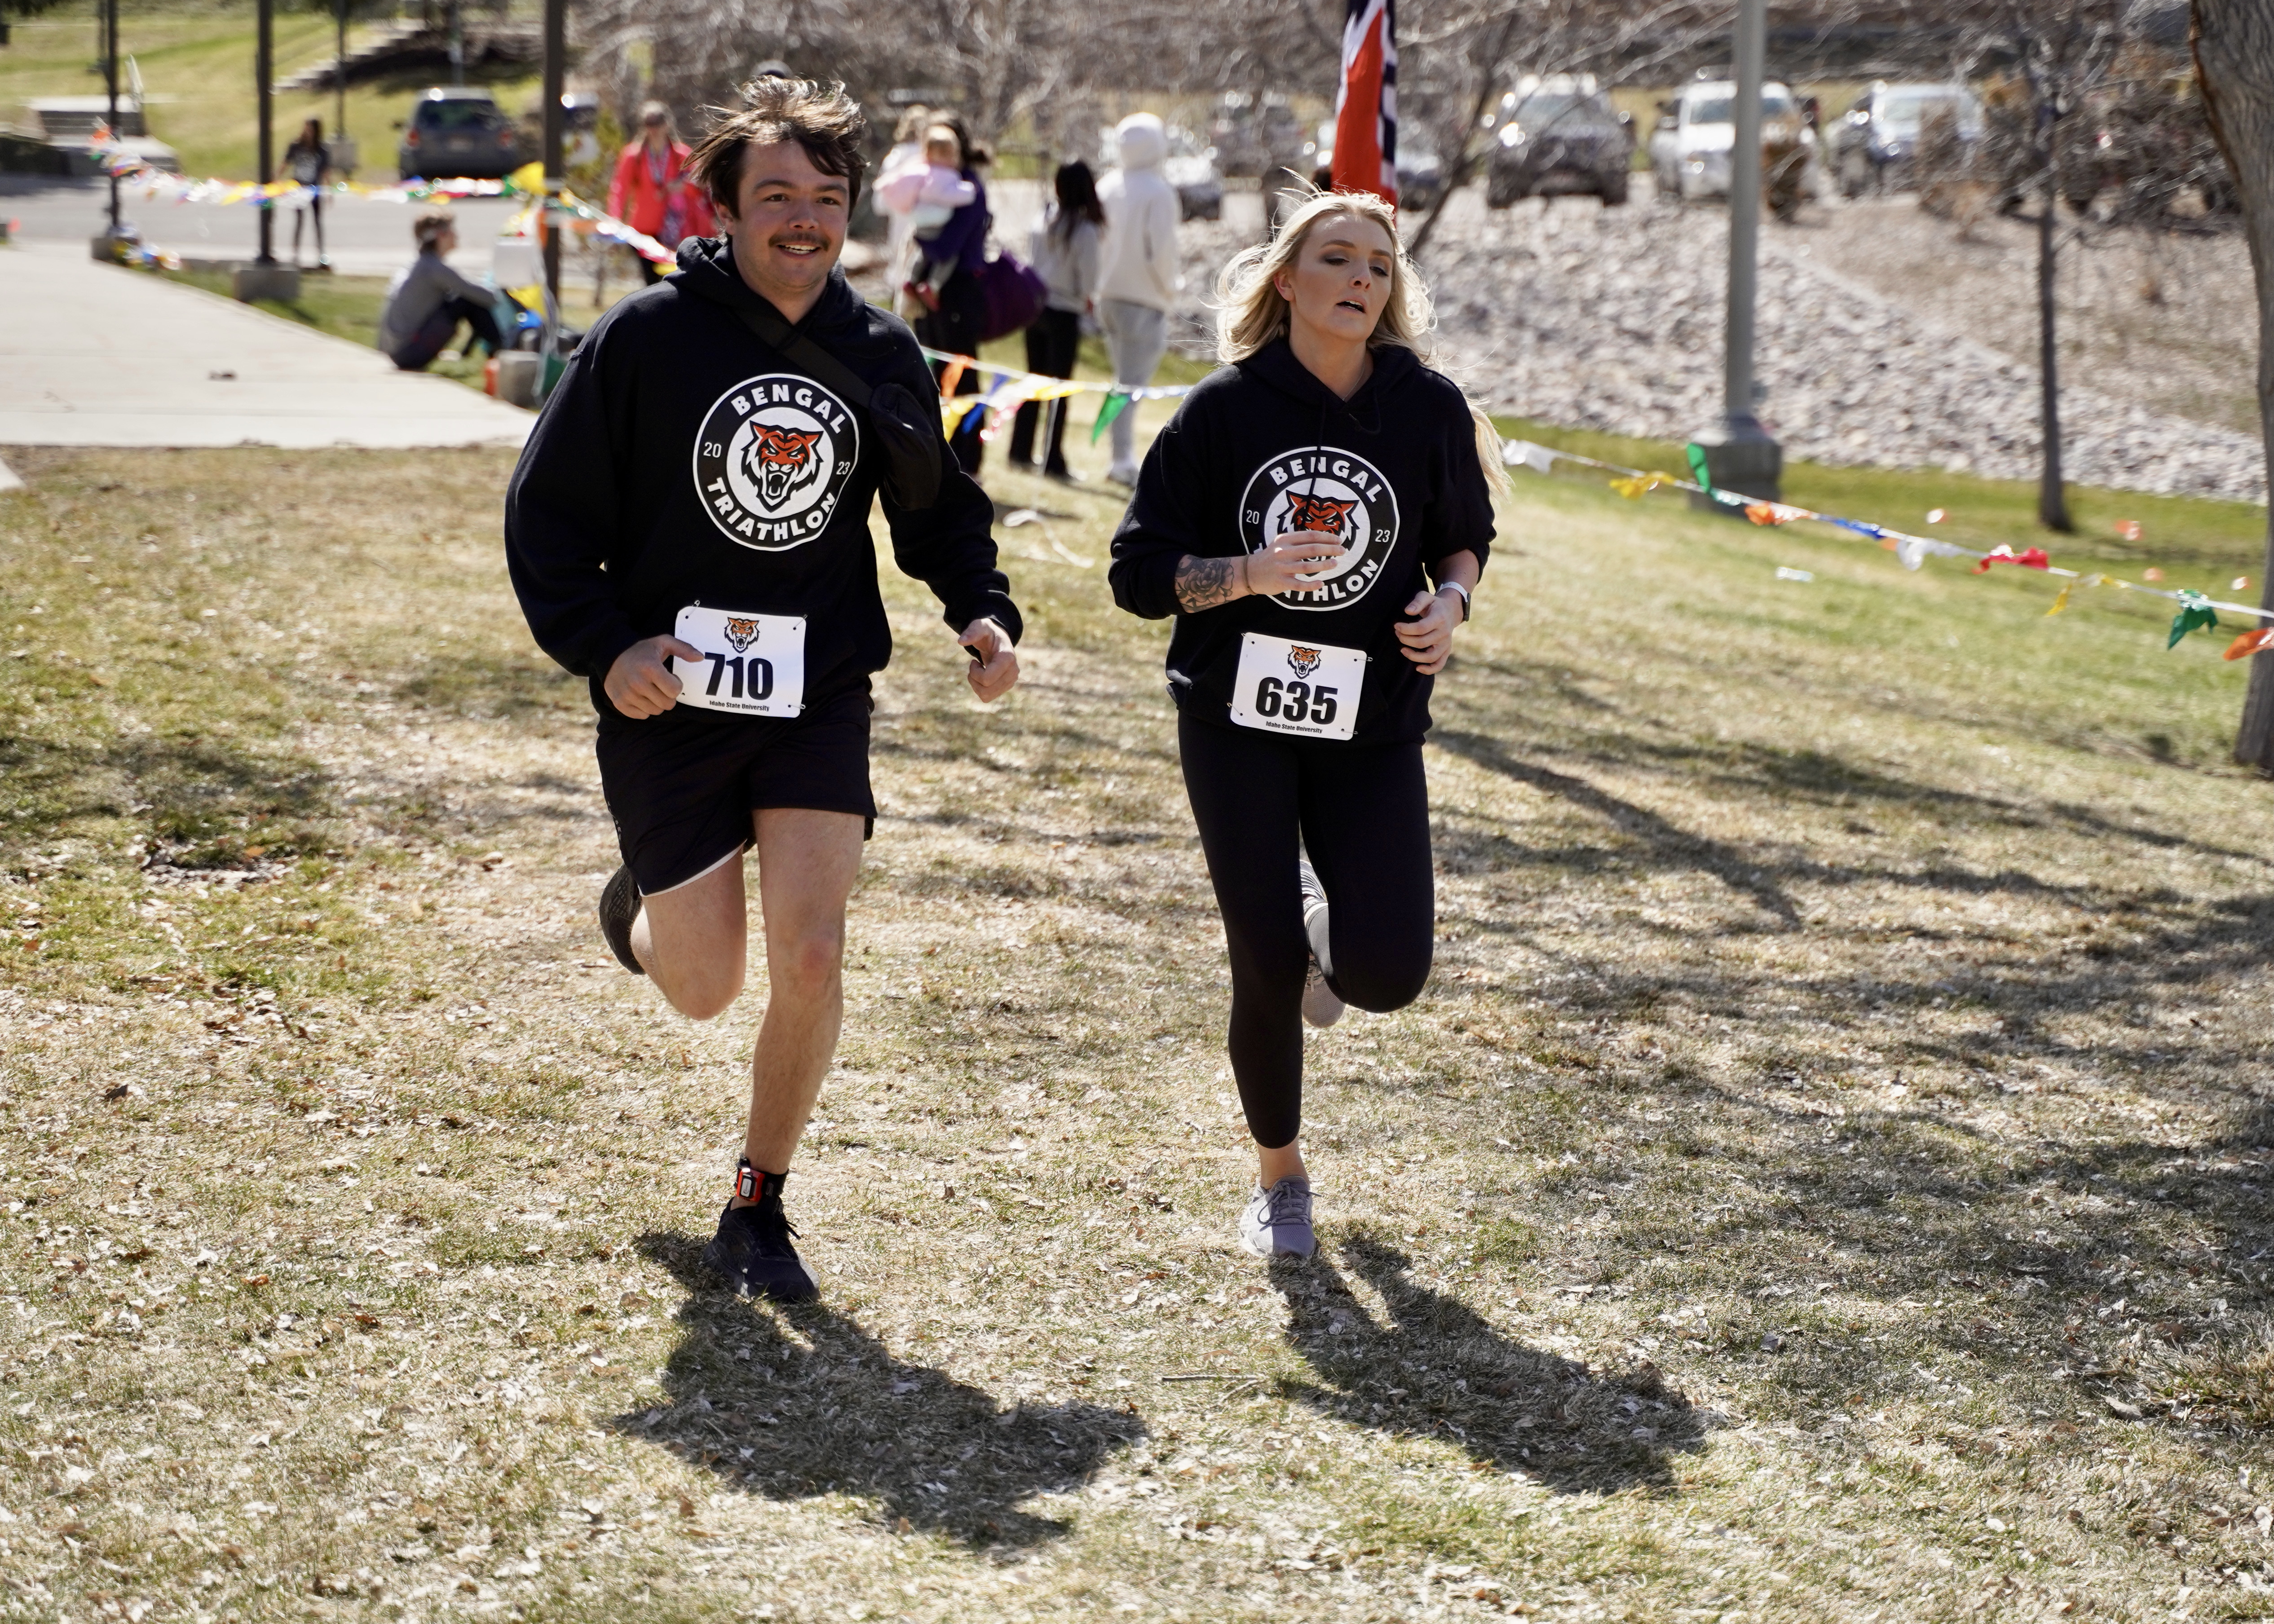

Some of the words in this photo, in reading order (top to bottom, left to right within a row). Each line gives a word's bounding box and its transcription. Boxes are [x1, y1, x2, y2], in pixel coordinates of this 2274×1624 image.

[731, 384, 846, 434] BENGAL
[703, 442, 722, 458] 20
[836, 462, 851, 475] 23
[1269, 457, 1382, 503] BENGAL
[707, 477, 835, 541] TRIATHLON
[1246, 510, 1260, 525] 20
[1375, 530, 1391, 543] 23
[705, 652, 773, 701] 710
[1256, 677, 1338, 725] 635
